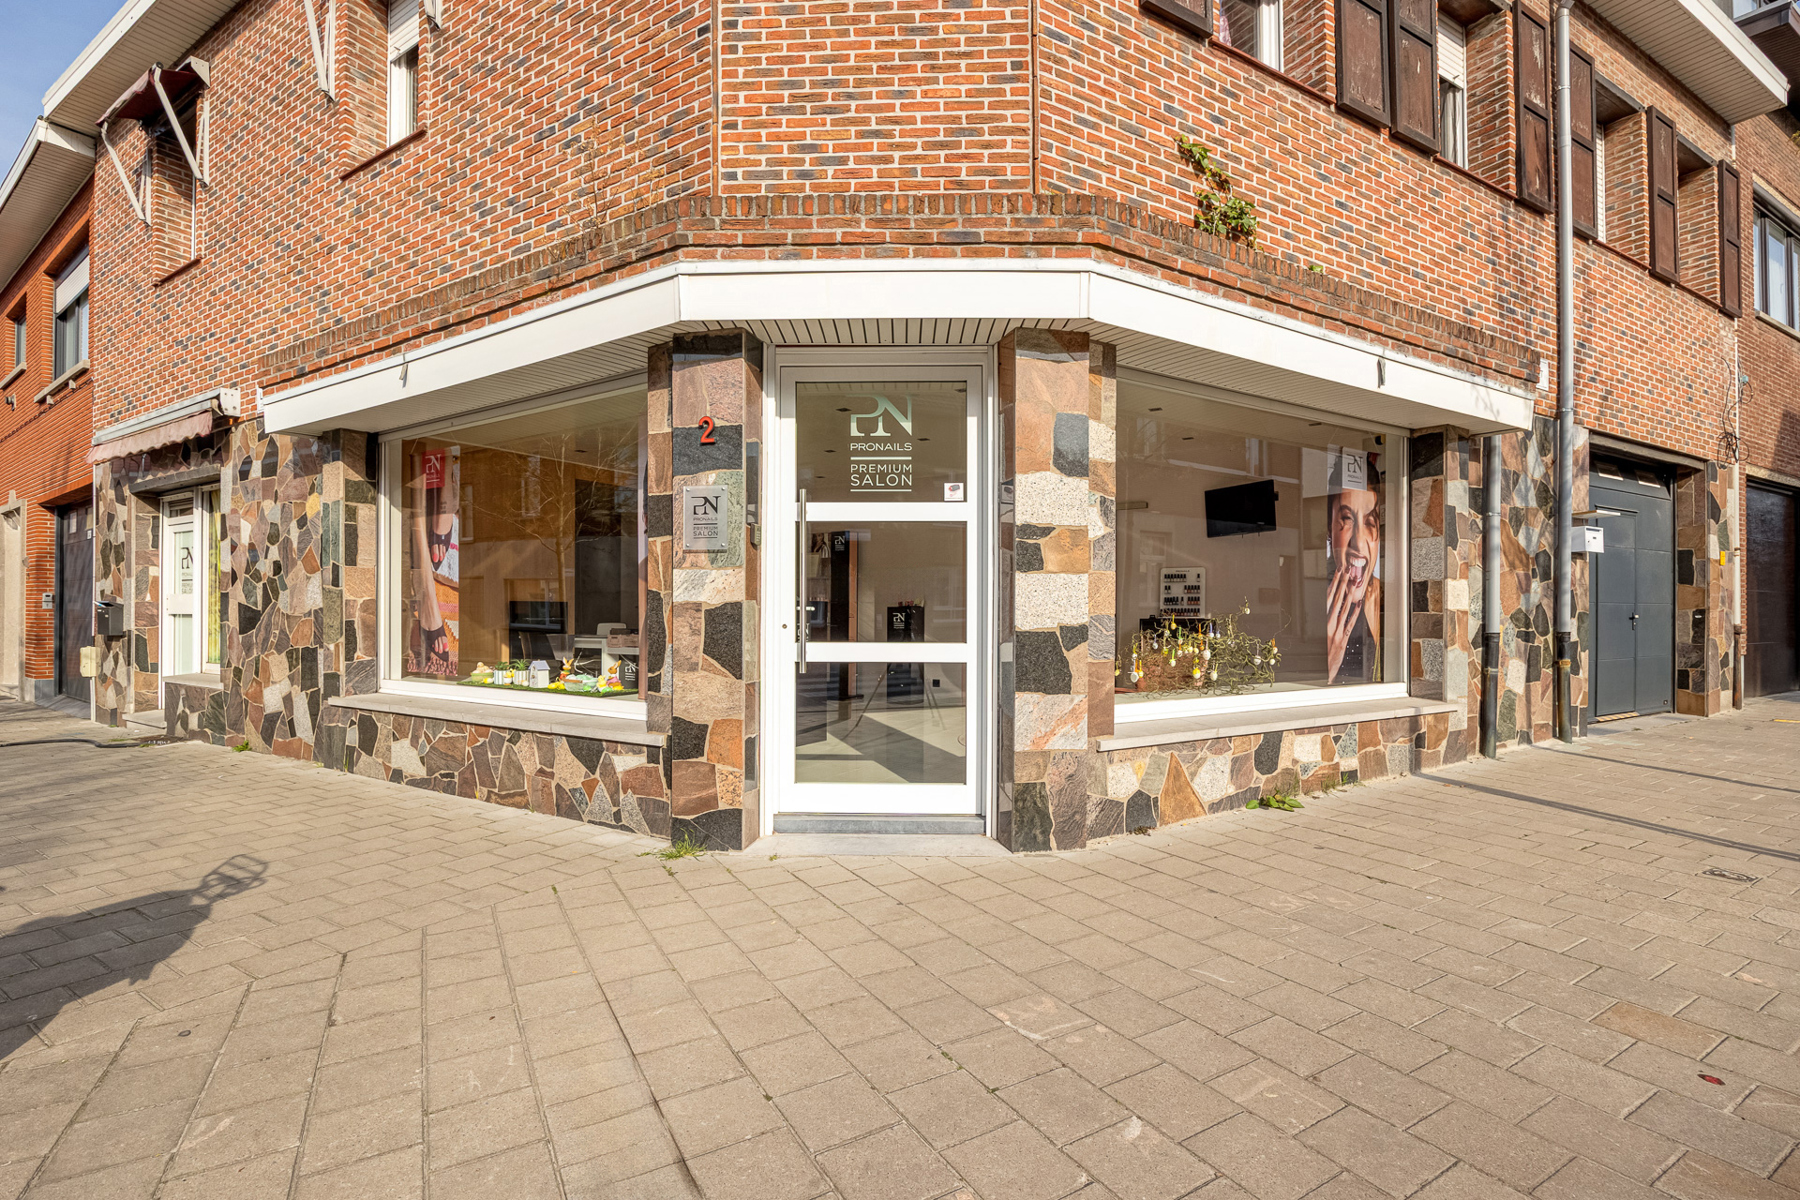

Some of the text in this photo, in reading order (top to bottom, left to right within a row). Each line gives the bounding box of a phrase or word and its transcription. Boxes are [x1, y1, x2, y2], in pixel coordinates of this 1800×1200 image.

[698, 416, 715, 443] 2
[850, 442, 912, 451] PRONAILS
[850, 463, 912, 473] PREMIUM
[850, 474, 912, 486] SALON
